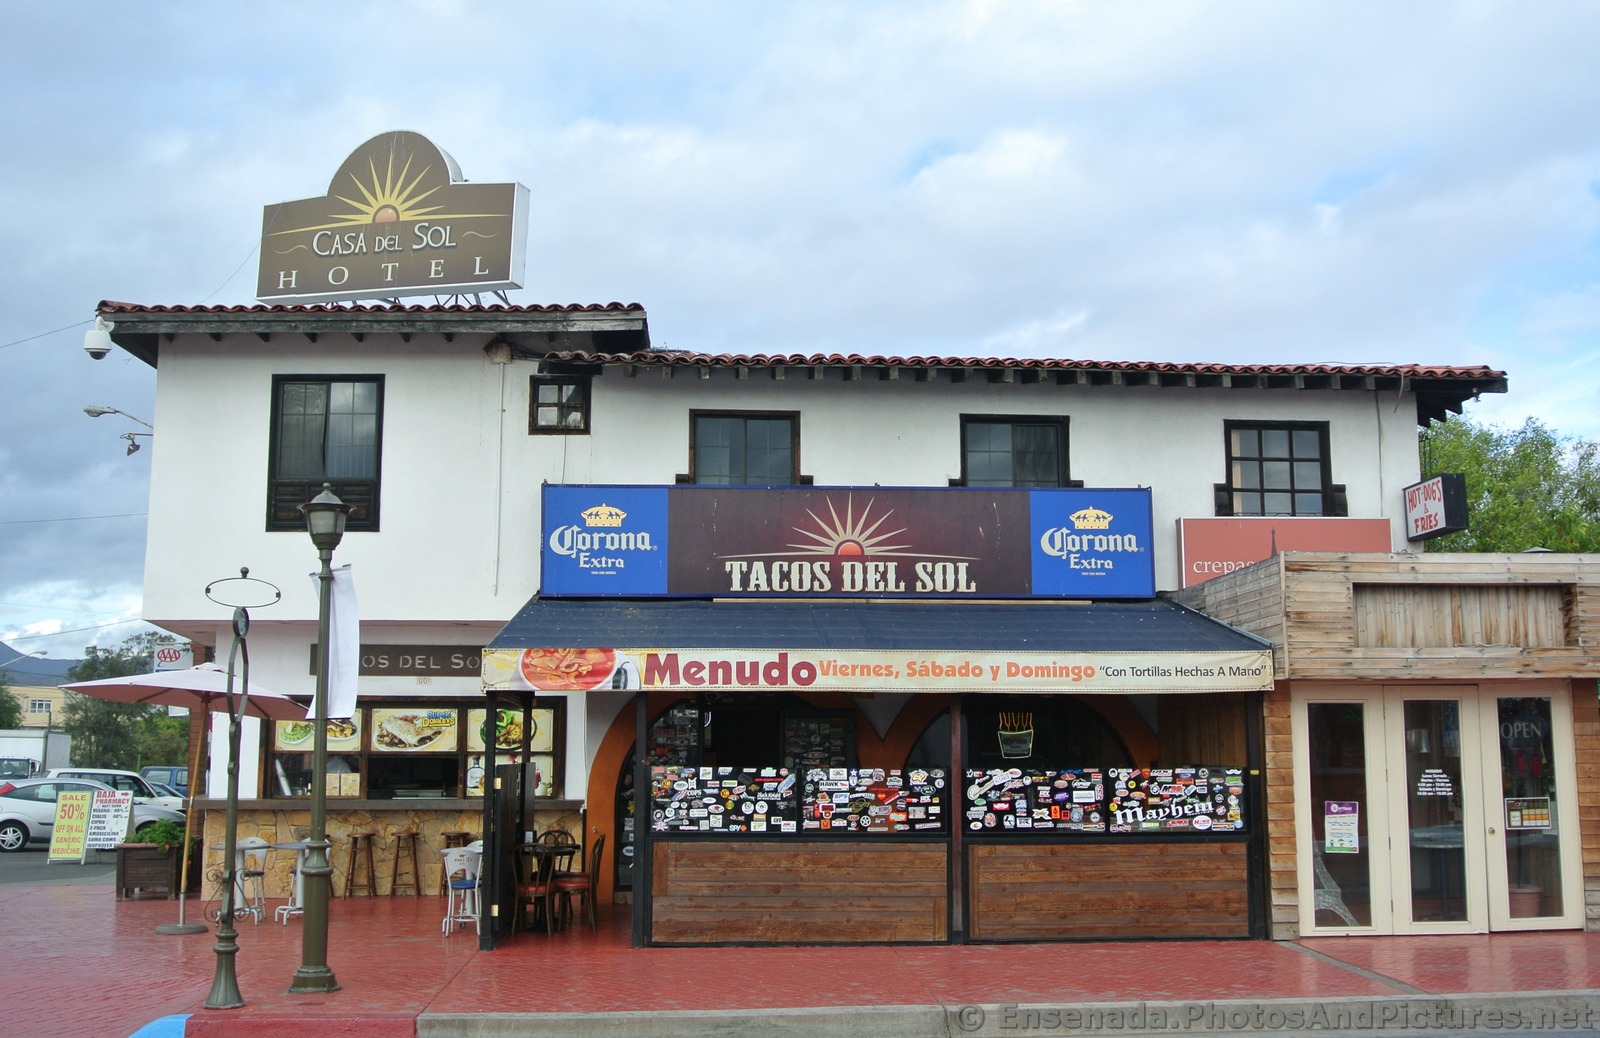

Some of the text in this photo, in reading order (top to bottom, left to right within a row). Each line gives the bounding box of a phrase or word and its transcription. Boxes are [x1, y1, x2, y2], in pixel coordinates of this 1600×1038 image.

[312, 231, 367, 256] CASA
[412, 222, 456, 249] SOL
[277, 256, 489, 289] HOTEL
[1414, 512, 1439, 533] FRIES
[549, 524, 652, 559] Corona
[1040, 526, 1139, 559] Corona
[579, 552, 625, 568] Extra
[1069, 554, 1114, 570] Extra
[724, 561, 977, 593] TACOS DEL SOL
[158, 649, 180, 662] AAA
[399, 655, 441, 669] DEL
[450, 654, 480, 669] SO
[643, 652, 818, 687] Menudo
[818, 660, 900, 680] Viernes,
[906, 660, 984, 678] Sábado
[989, 664, 1000, 681] y
[1006, 661, 1096, 683] Domingo
[1129, 666, 1172, 677] Tortillas
[1175, 666, 1215, 677] Hechas
[1217, 667, 1226, 677] A
[1501, 722, 1542, 739] OPEN
[60, 804, 85, 820] 50%
[1113, 801, 1215, 825] Mayhem
[56, 824, 83, 833] OFF ON ALL
